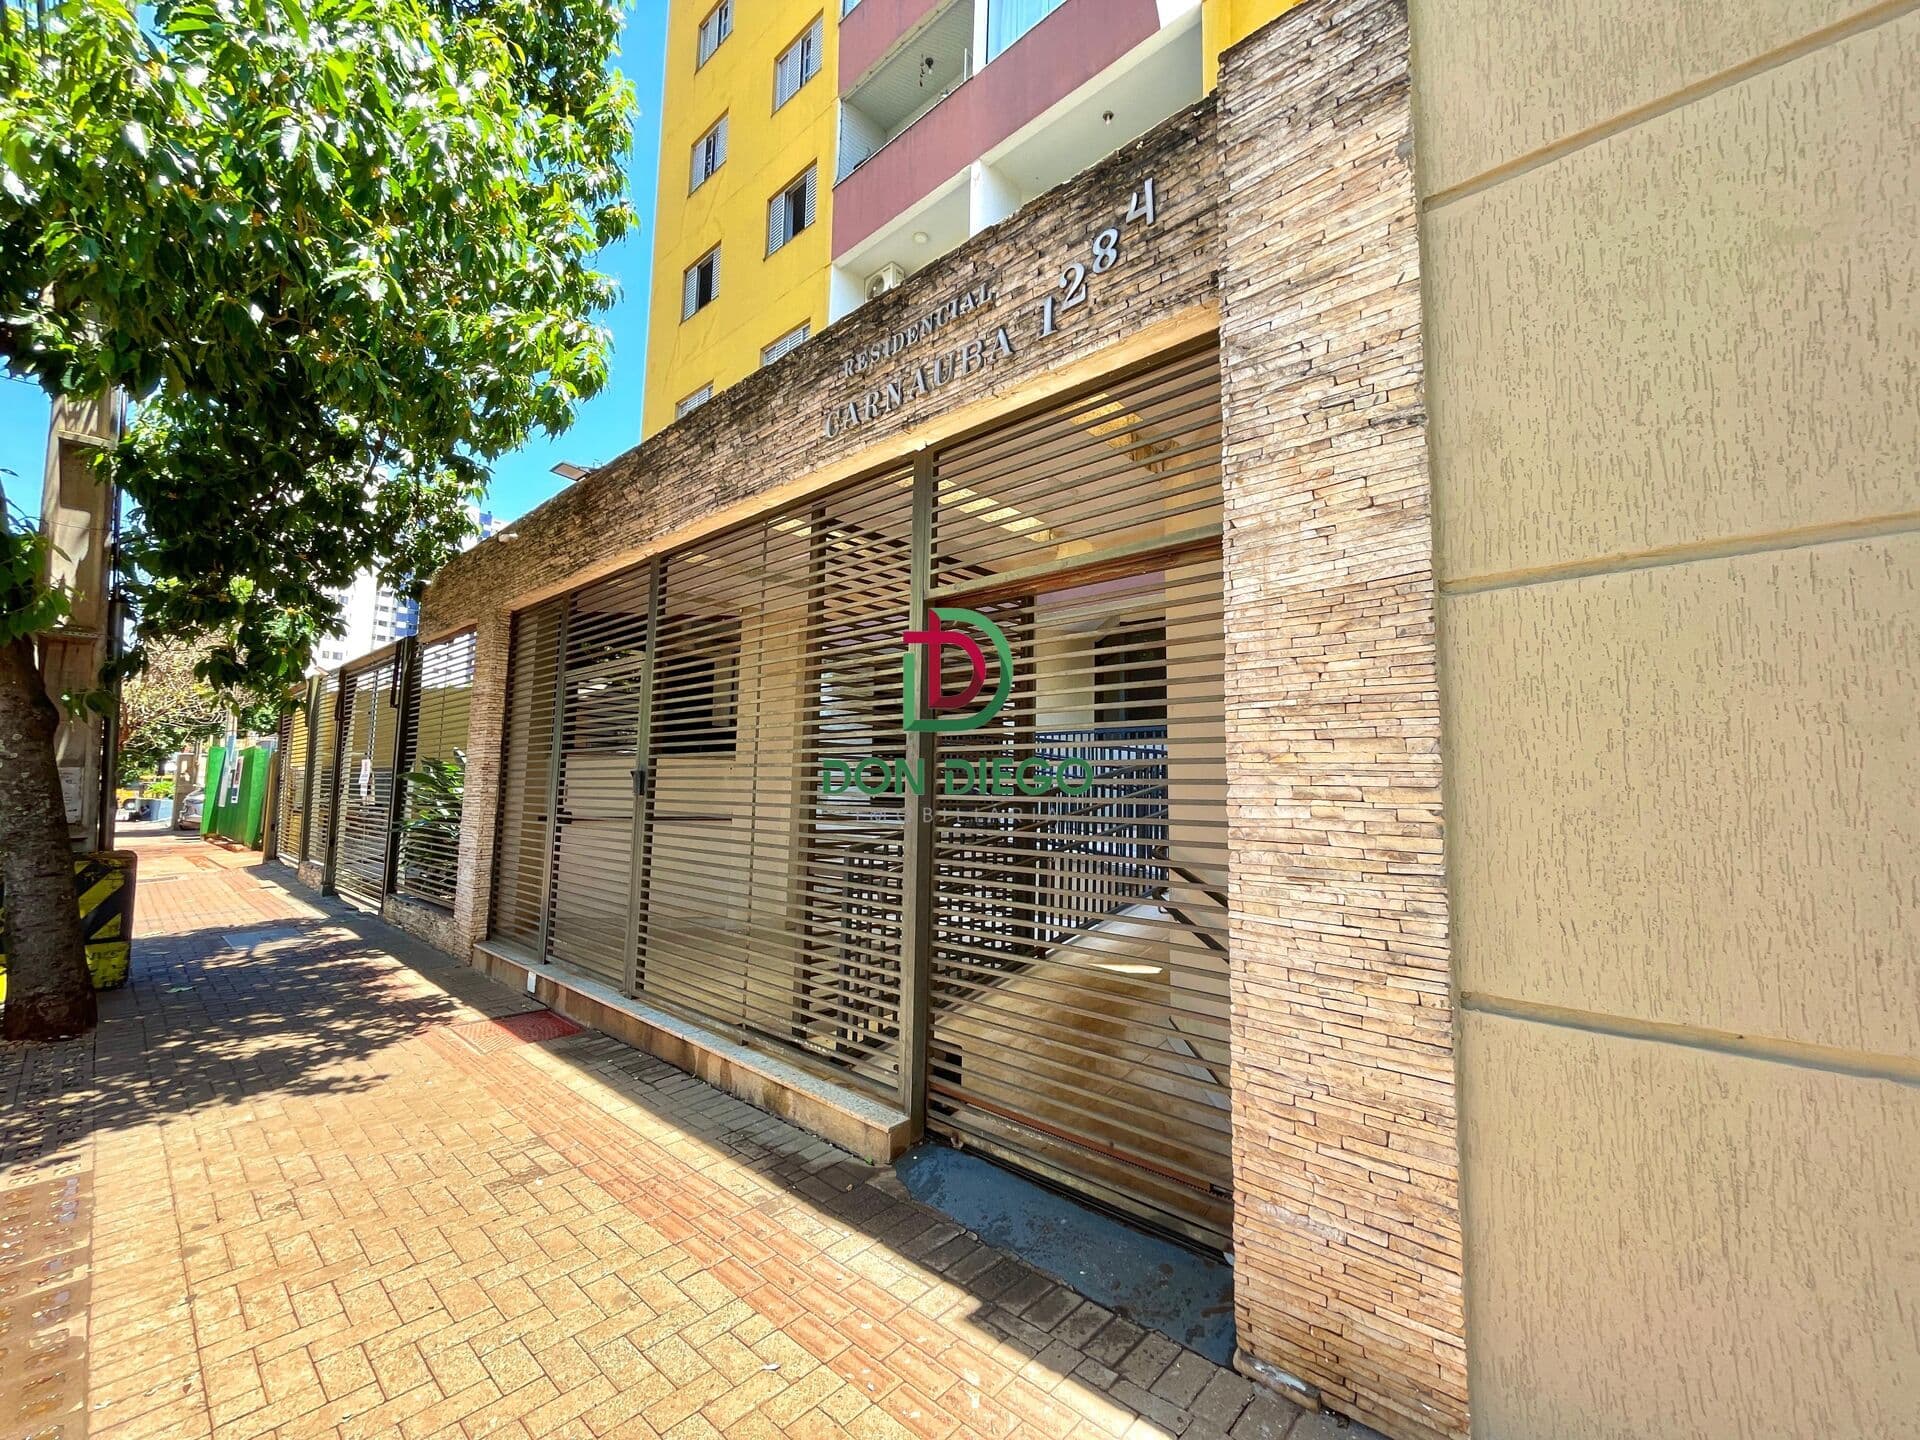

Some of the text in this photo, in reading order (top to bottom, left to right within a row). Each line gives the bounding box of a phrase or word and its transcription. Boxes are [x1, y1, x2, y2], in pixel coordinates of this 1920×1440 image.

[824, 177, 1155, 438] CARNAUBA 1284
[843, 282, 996, 378] RESIDENCIAL
